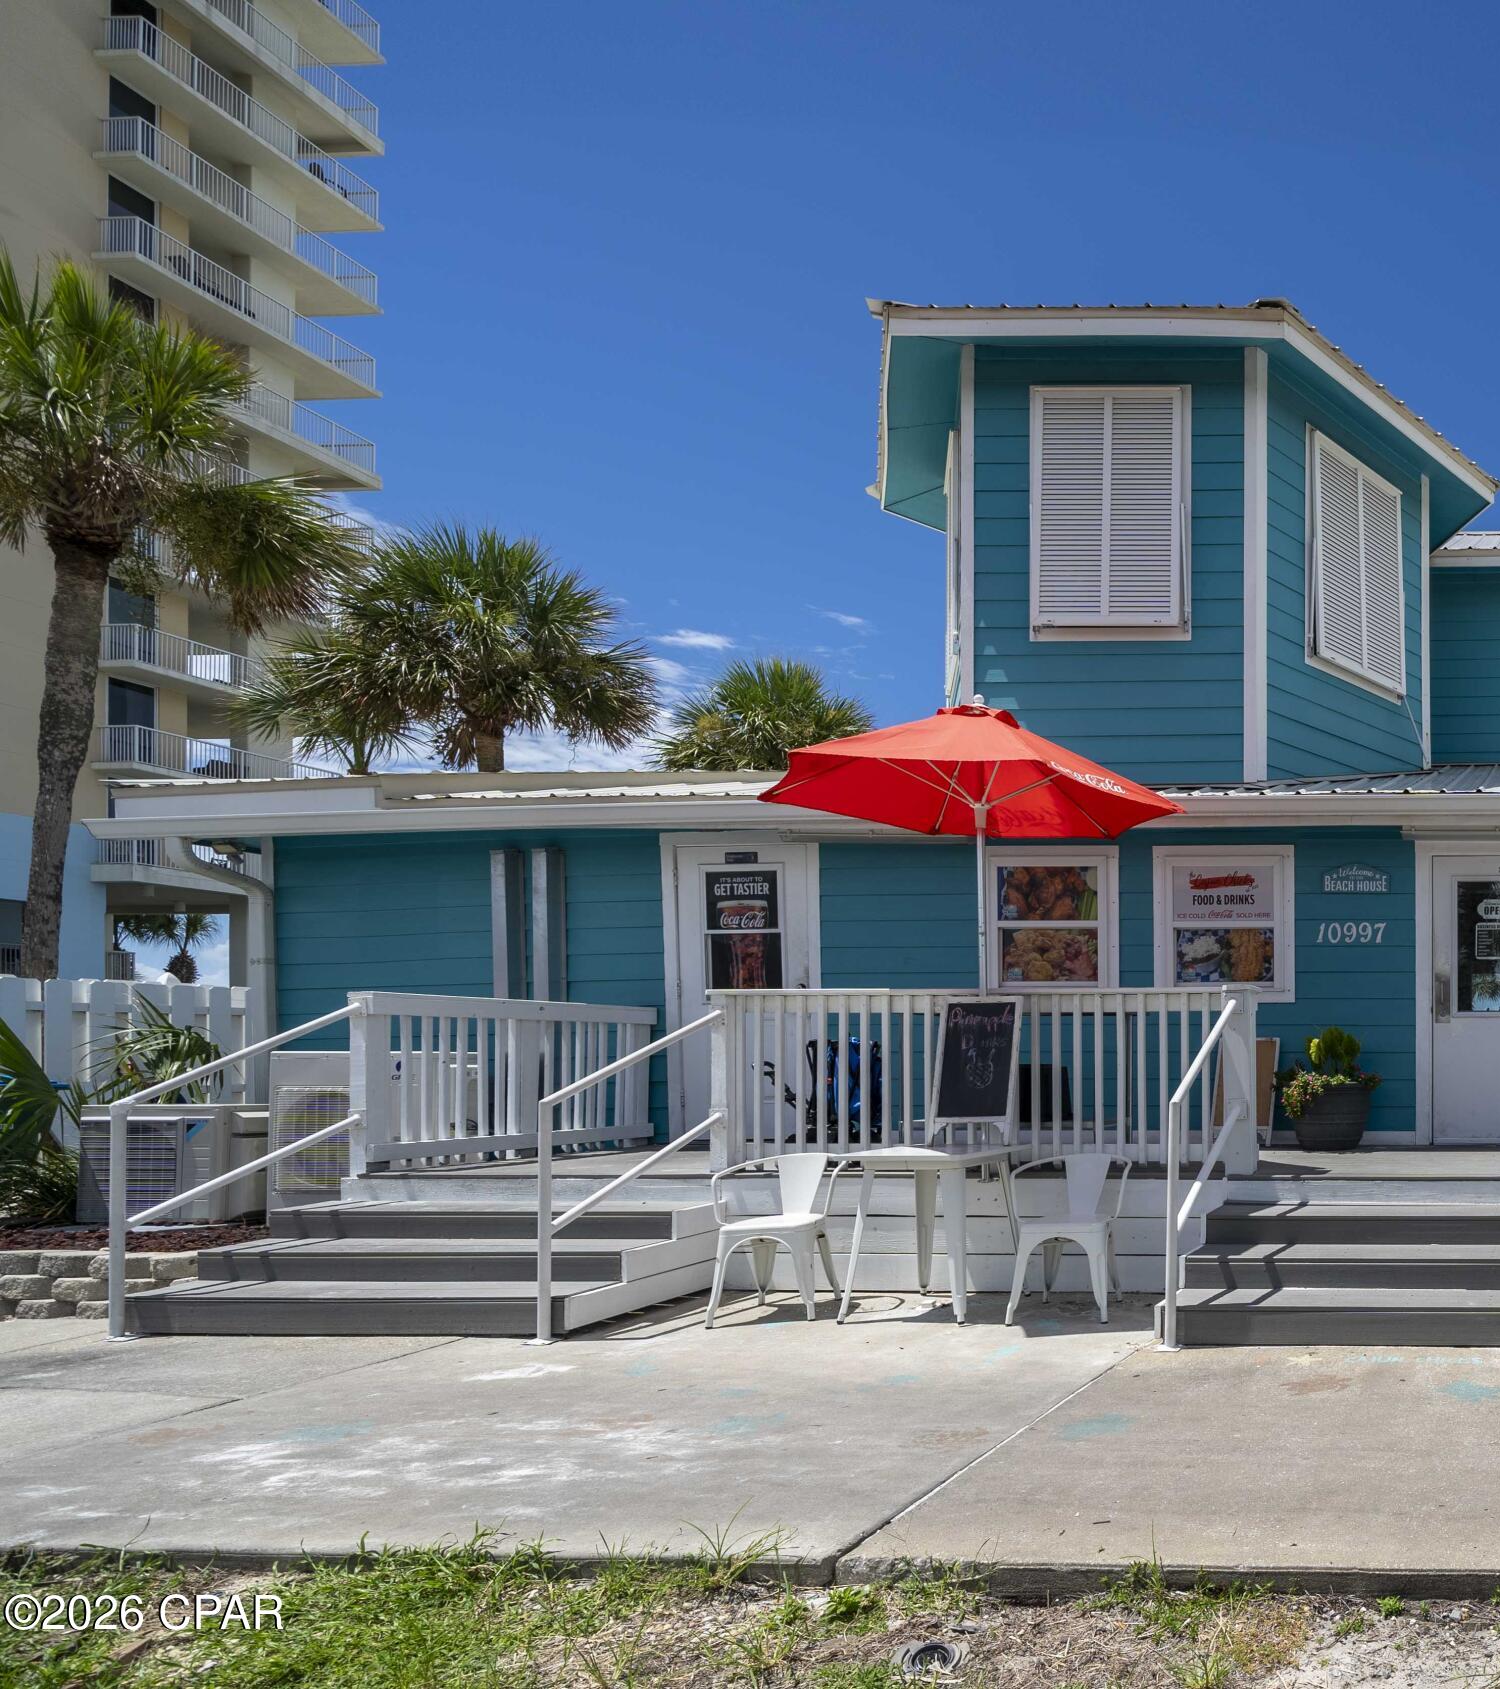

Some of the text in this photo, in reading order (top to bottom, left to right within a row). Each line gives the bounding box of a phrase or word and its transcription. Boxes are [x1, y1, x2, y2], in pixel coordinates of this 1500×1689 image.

[714, 883, 769, 895] GET TASTIER
[1324, 875, 1388, 892] BEACH HOUSE
[1192, 894, 1256, 906] FOOD & DRINKS
[720, 911, 765, 928] Coca-Cola
[1316, 921, 1387, 944] 10997
